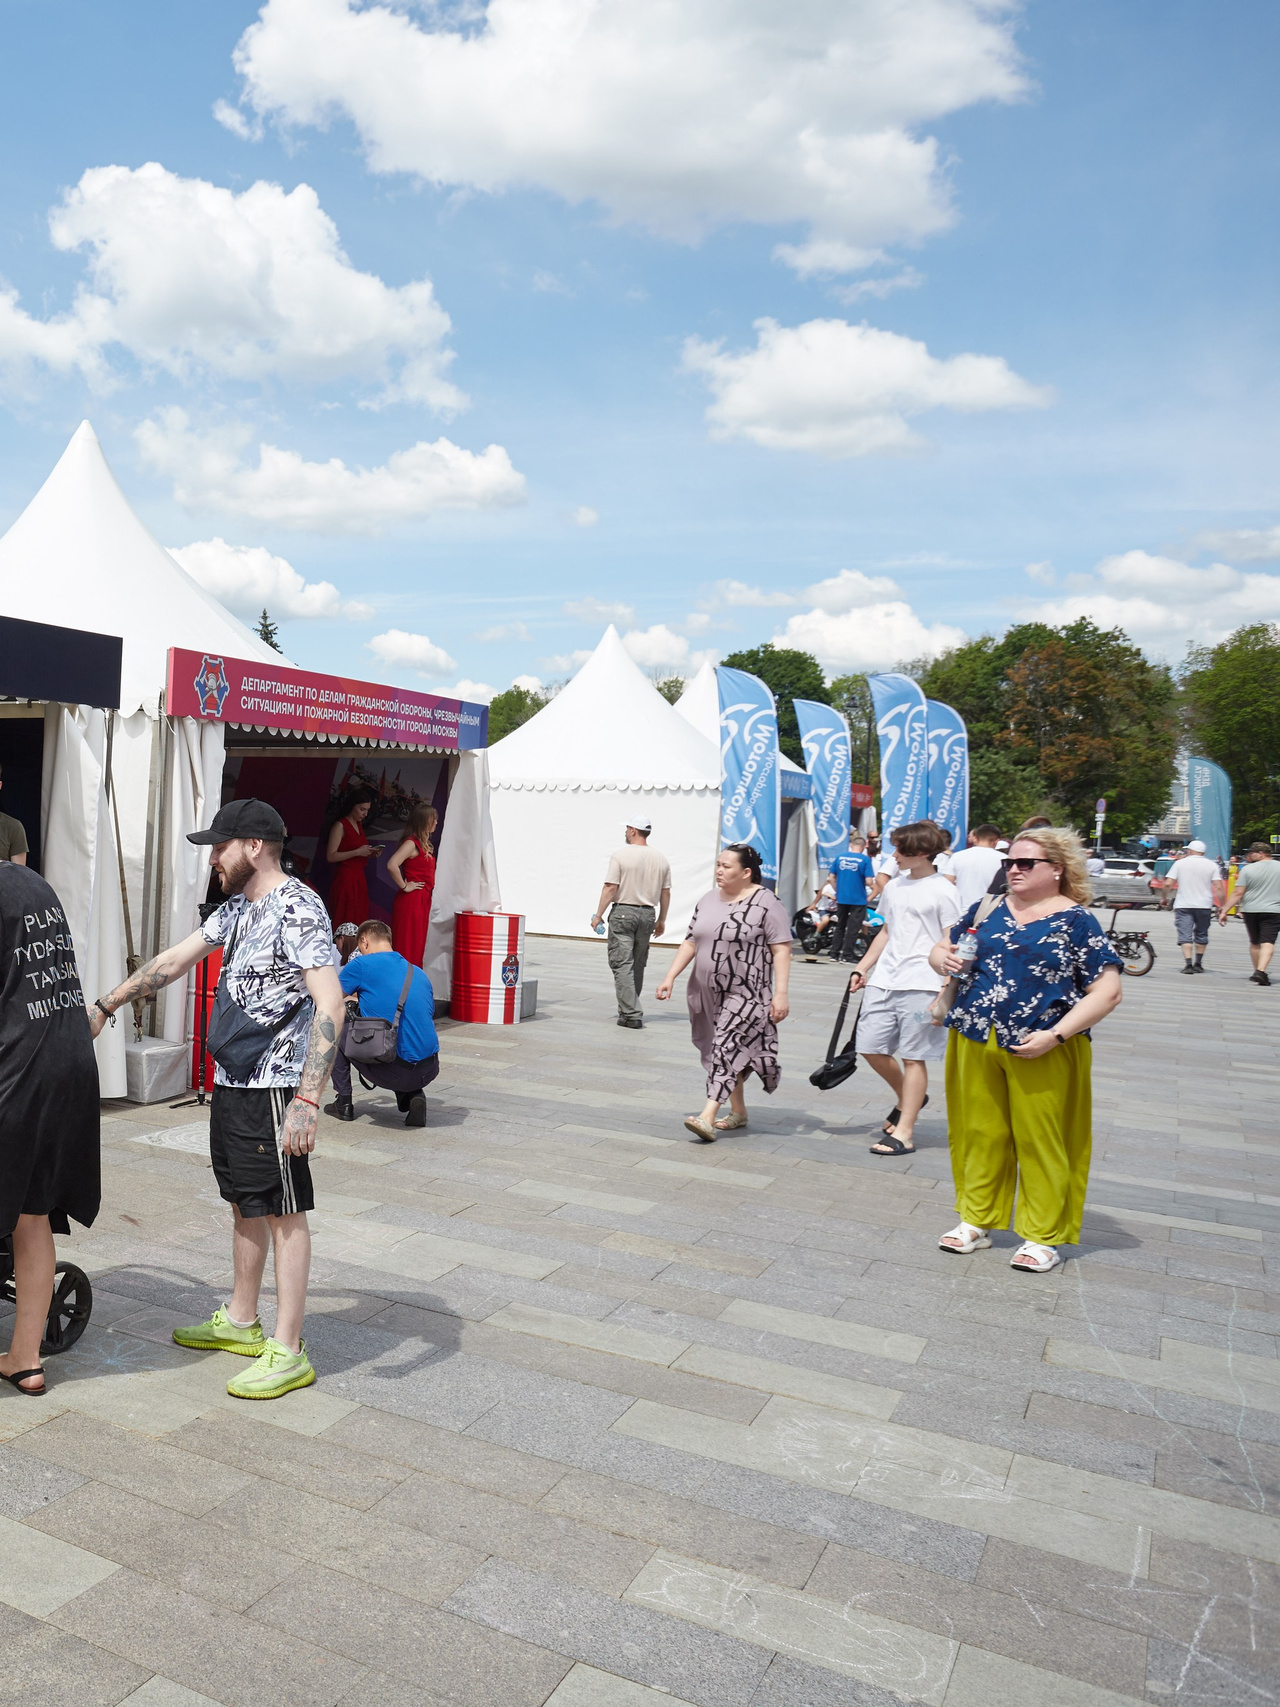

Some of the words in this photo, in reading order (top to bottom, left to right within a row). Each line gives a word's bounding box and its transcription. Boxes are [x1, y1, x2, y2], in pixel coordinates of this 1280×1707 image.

[240, 676, 304, 699] ДЕПАРТАМЕНТ
[305, 687, 318, 701] ПО
[319, 690, 346, 705] ДЕЛАМ
[347, 694, 399, 713] ГРАЖДАНСКОЙ
[400, 704, 433, 720] ОБОРОНЫ,
[434, 708, 480, 727] ЧРЕЗВЫЧАЙНЫМ
[240, 696, 295, 716] СИТУАЦИЯМ
[296, 704, 303, 716] И
[304, 705, 350, 724] ПОЖАРНОЙ
[350, 712, 406, 731] БЕЗОПАСНОСТИ
[406, 720, 432, 735] ГОРОДА
[432, 724, 458, 739] МОСКВЫ
